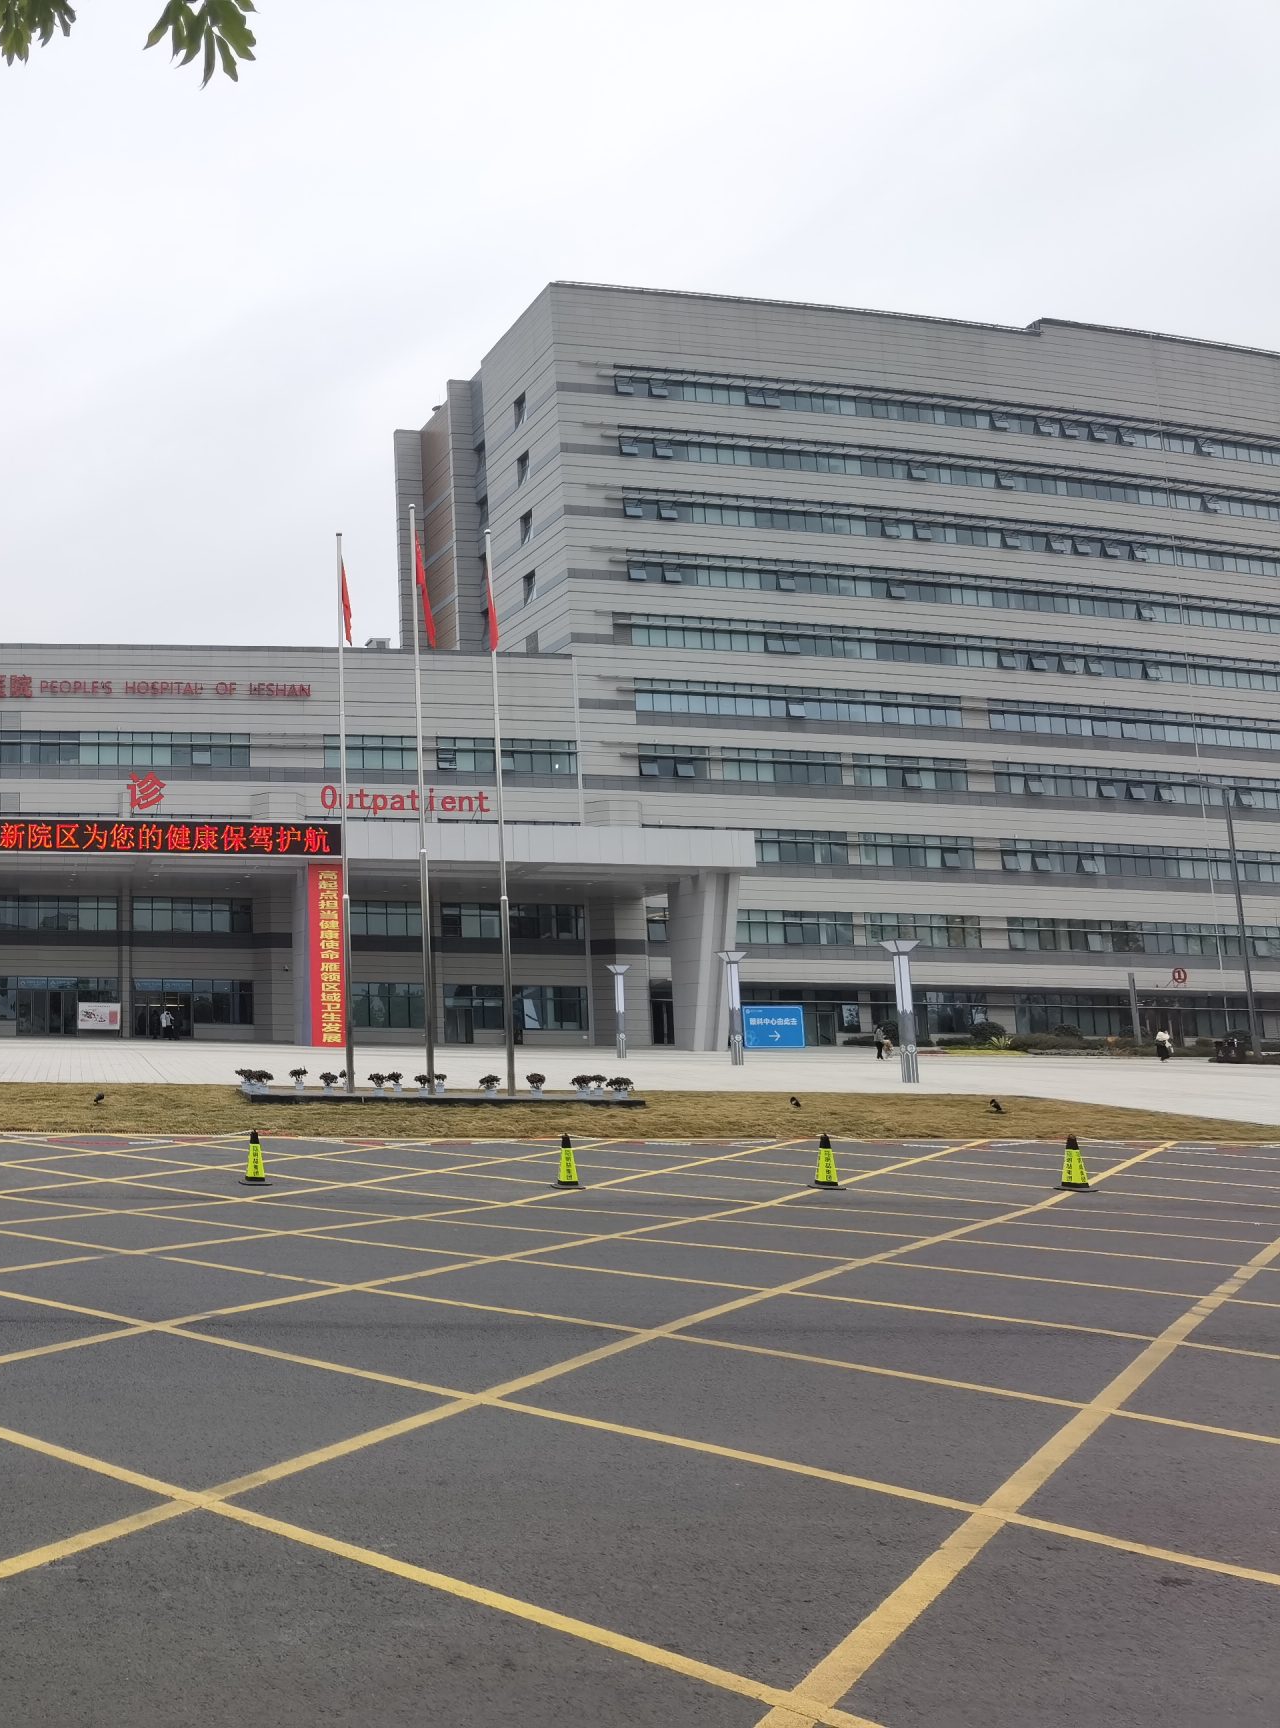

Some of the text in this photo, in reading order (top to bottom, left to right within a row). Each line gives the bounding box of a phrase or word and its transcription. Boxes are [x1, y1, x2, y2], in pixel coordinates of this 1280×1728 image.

[40, 680, 311, 697] PEOPLE'S HOSPITAL OF LESHAN
[320, 785, 491, 816] Outpatient
[749, 1017, 798, 1026] 眼科中心由此去
